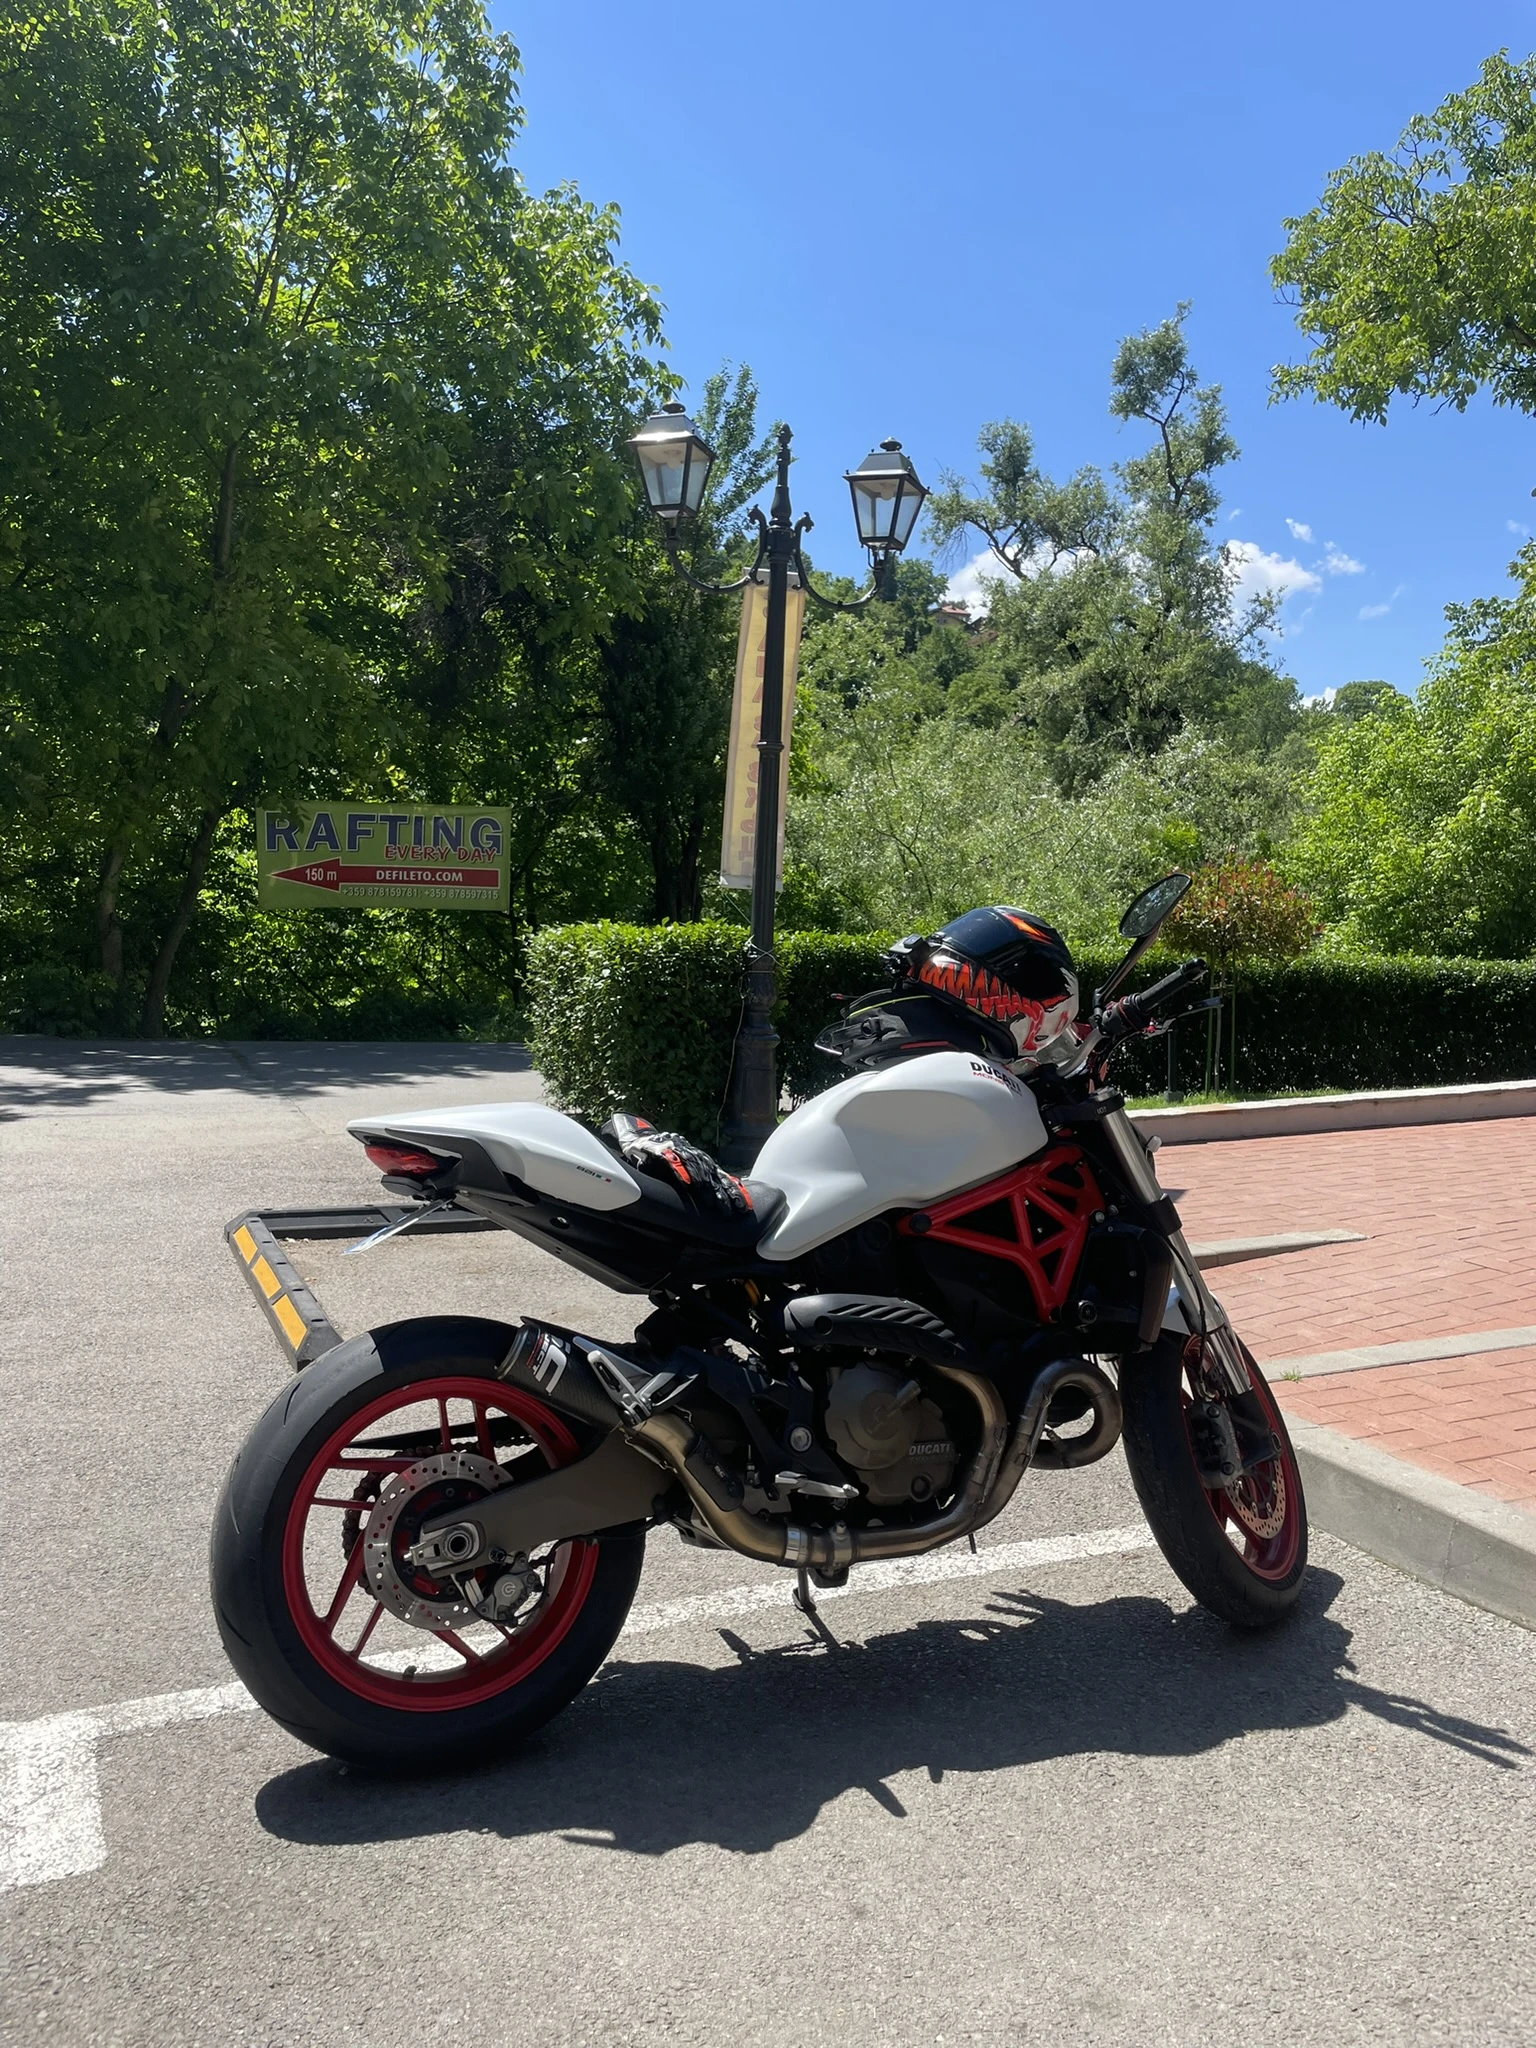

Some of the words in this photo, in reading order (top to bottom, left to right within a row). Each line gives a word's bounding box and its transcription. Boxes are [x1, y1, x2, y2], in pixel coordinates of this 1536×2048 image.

[265, 811, 502, 855] RAFTING
[384, 844, 450, 861] EVERY
[456, 845, 497, 863] DAY
[304, 868, 324, 881] 150
[327, 870, 337, 881] m
[375, 870, 463, 882] DEFILETO.COM
[342, 887, 365, 897] +359
[424, 888, 447, 898] +359
[970, 1061, 1021, 1093] DUCATI
[909, 1443, 950, 1456] DUCATI
